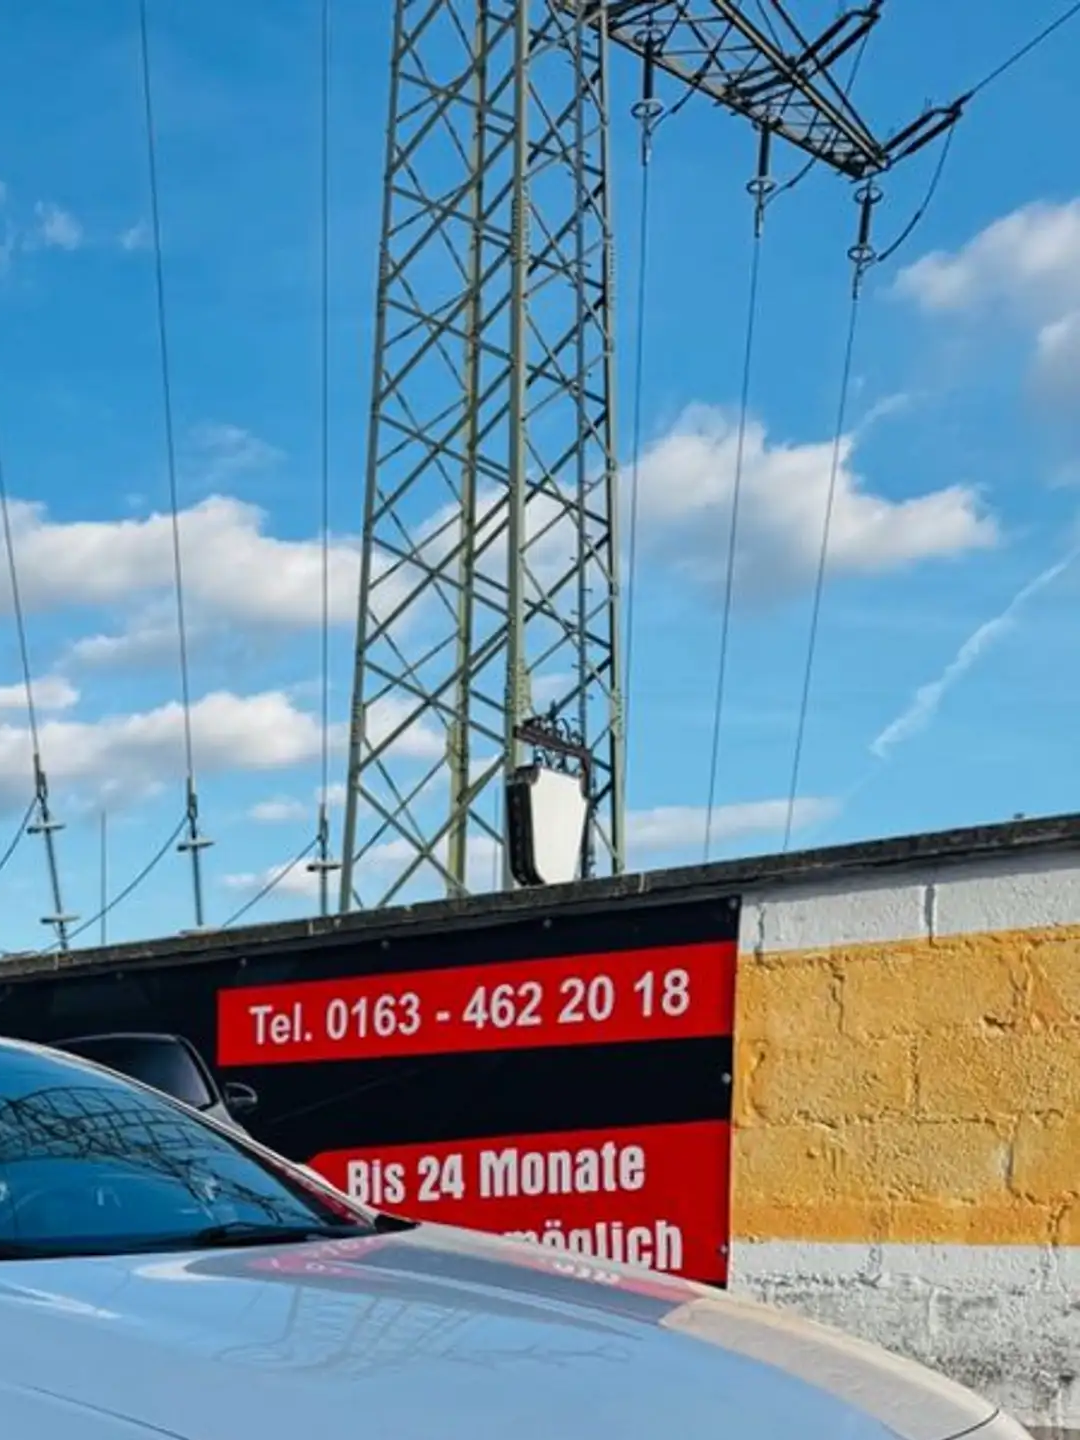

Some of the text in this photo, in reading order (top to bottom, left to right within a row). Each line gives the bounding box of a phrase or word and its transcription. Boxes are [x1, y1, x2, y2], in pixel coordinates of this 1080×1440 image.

[248, 967, 690, 1044] Tel. 0163 - 462 20 18
[347, 1140, 646, 1205] Bis 24 Monate
